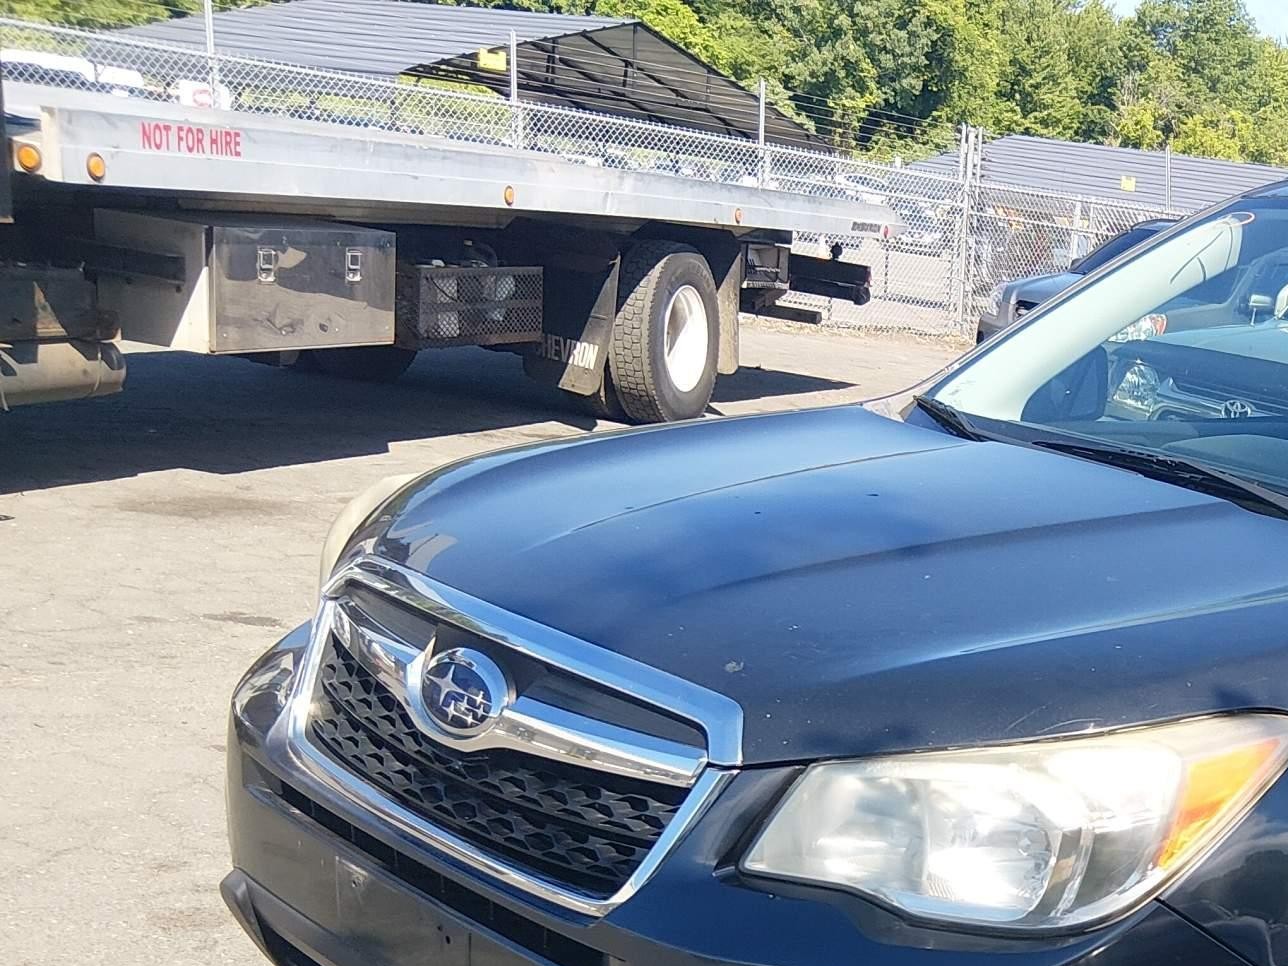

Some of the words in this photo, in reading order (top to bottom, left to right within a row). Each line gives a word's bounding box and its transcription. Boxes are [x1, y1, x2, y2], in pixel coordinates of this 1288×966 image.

[141, 121, 172, 151] NOT
[176, 124, 206, 155] FOR
[209, 127, 242, 158] HIRE
[539, 333, 599, 371] HEVRON
